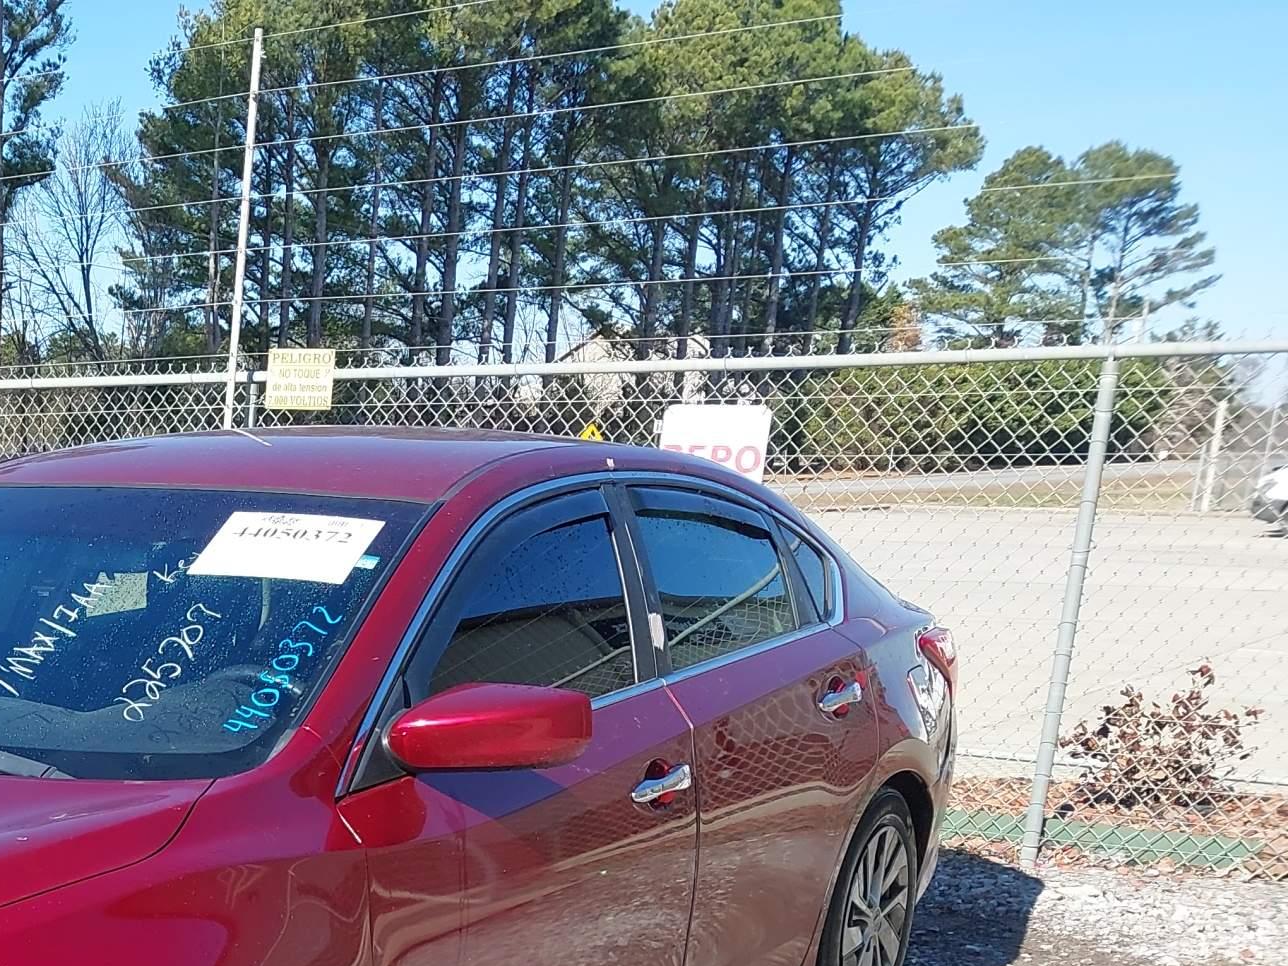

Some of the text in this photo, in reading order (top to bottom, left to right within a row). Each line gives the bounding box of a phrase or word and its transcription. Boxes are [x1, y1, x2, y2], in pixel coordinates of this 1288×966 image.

[273, 352, 332, 364] PELIGRO
[279, 368, 321, 379] NO TOQUE
[272, 383, 282, 392] de
[283, 383, 297, 392] alta
[662, 444, 762, 474] PO
[233, 526, 353, 544] 44050372
[223, 606, 344, 732] 44050372
